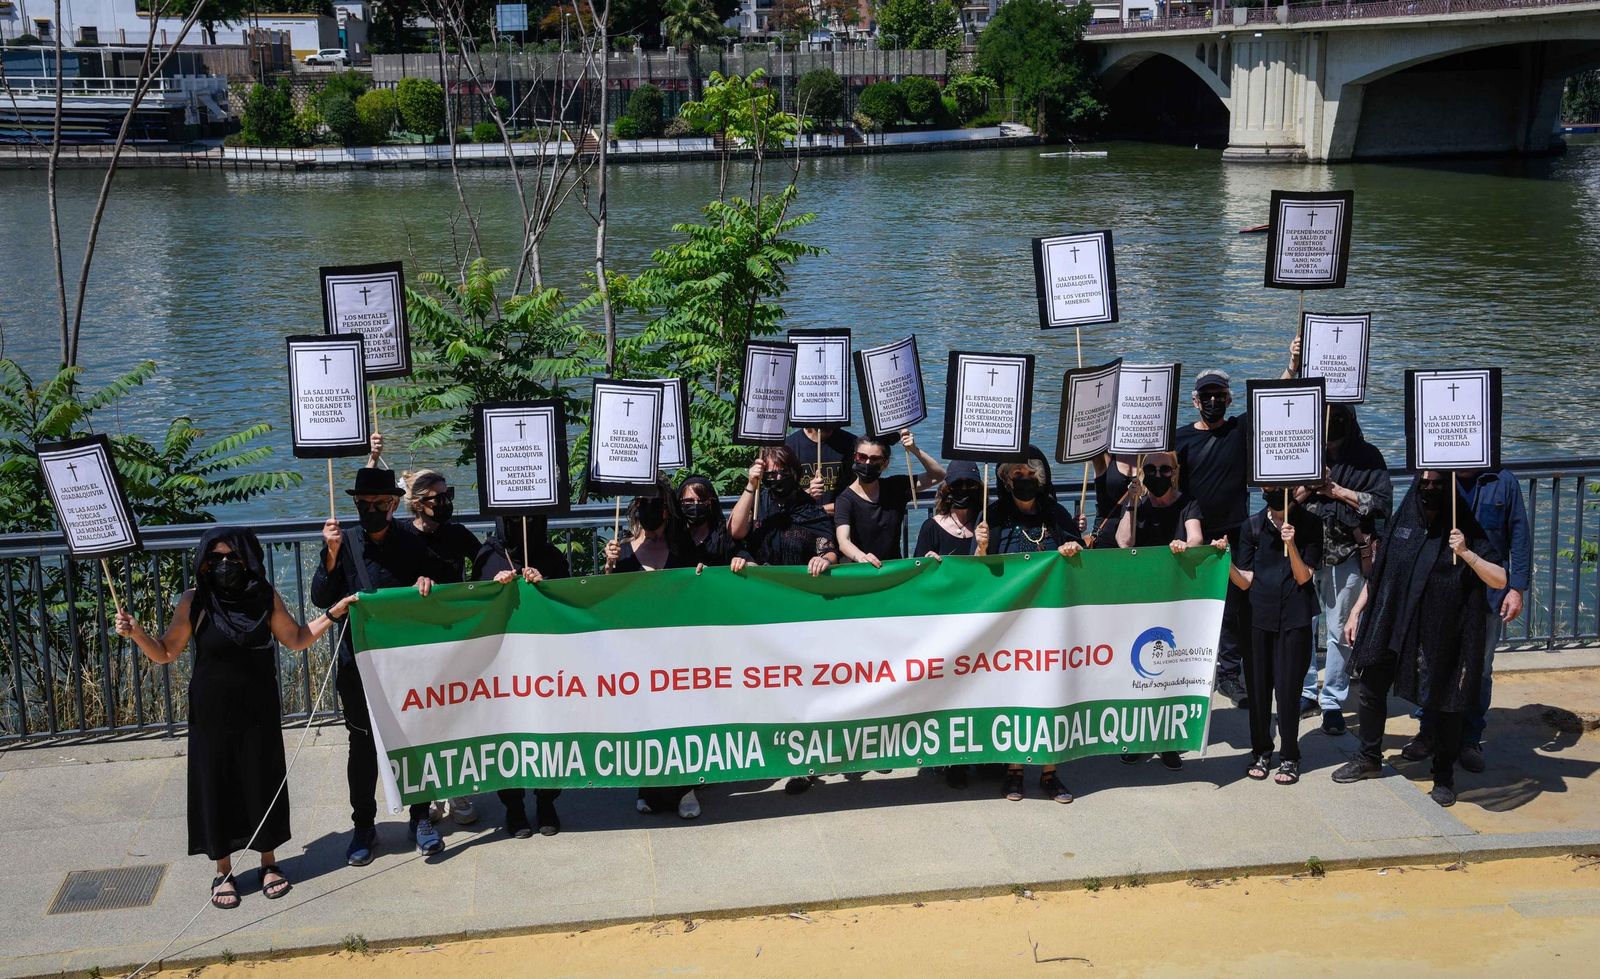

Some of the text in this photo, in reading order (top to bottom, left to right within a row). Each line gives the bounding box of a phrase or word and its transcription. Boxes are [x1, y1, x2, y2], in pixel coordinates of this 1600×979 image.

[1056, 280, 1097, 288] GUADALQUIVIR
[61, 484, 90, 493] SALVEMOS
[61, 490, 104, 500] GUADALQUIVIR
[86, 504, 107, 512] AGUAS
[69, 517, 108, 528] PROCEDENTES
[401, 644, 1114, 712] ANDALUCÍA NO DEBE SER ZONA DE SACRIFICIO
[594, 730, 765, 777] CIUDADANA
[773, 719, 941, 767] “SALVEMOS
[991, 714, 1032, 753] EL
[1032, 703, 1203, 753] GUADALQUIVIR”
